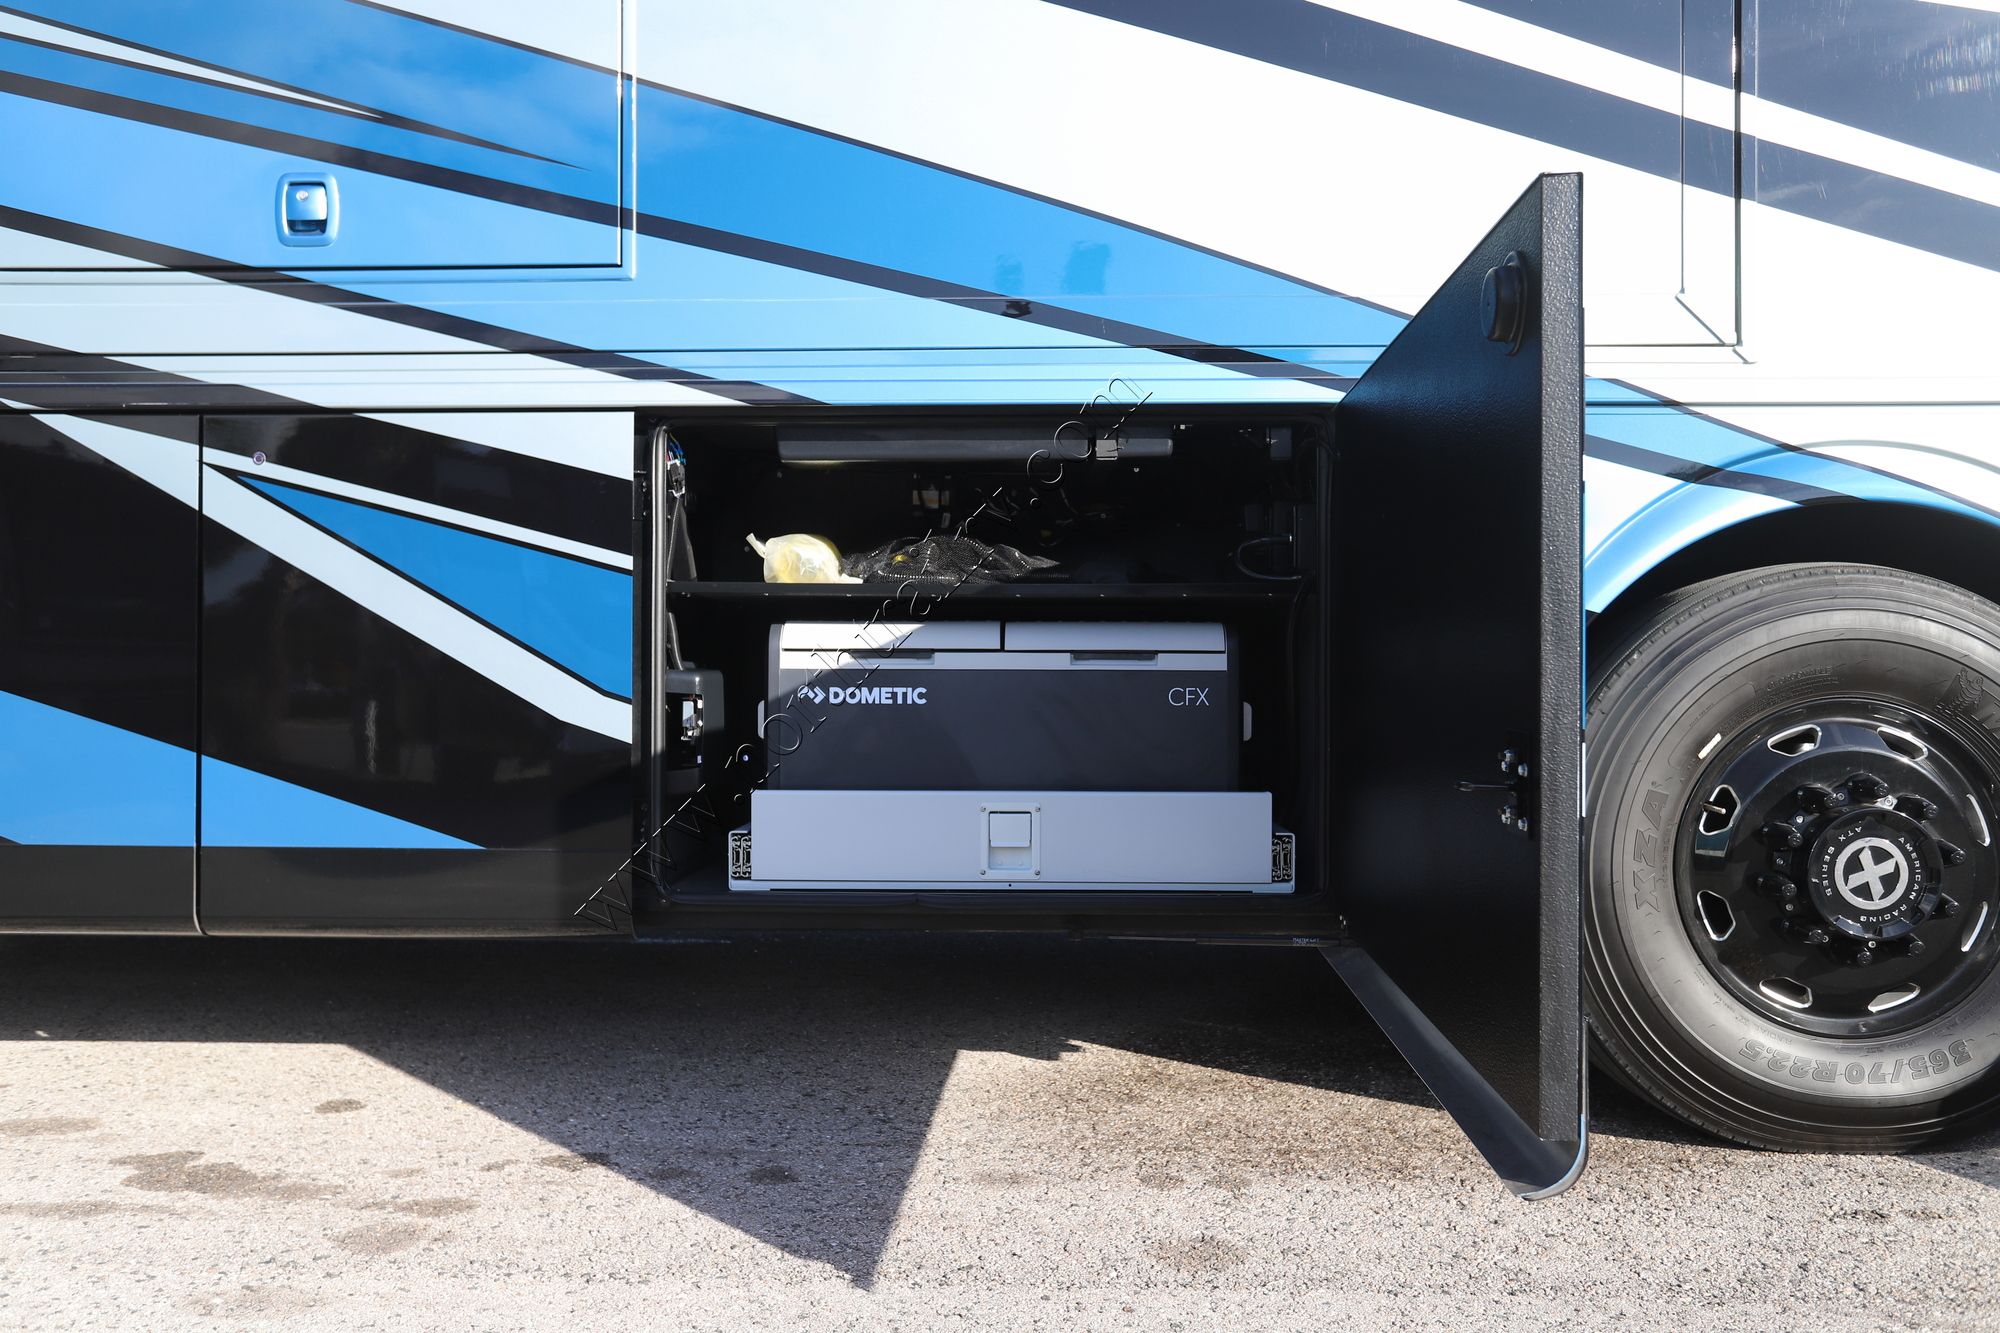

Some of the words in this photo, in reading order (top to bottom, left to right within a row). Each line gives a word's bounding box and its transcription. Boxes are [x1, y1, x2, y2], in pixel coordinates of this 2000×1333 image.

[829, 686, 928, 705] DOMETIC
[1168, 687, 1210, 706] CFX
[1838, 825, 1862, 842] ATX
[1632, 788, 1670, 913] XZA
[1821, 845, 1836, 897] SERIES
[1898, 836, 1921, 900] AMERICAN
[1859, 903, 1908, 923] RACING
